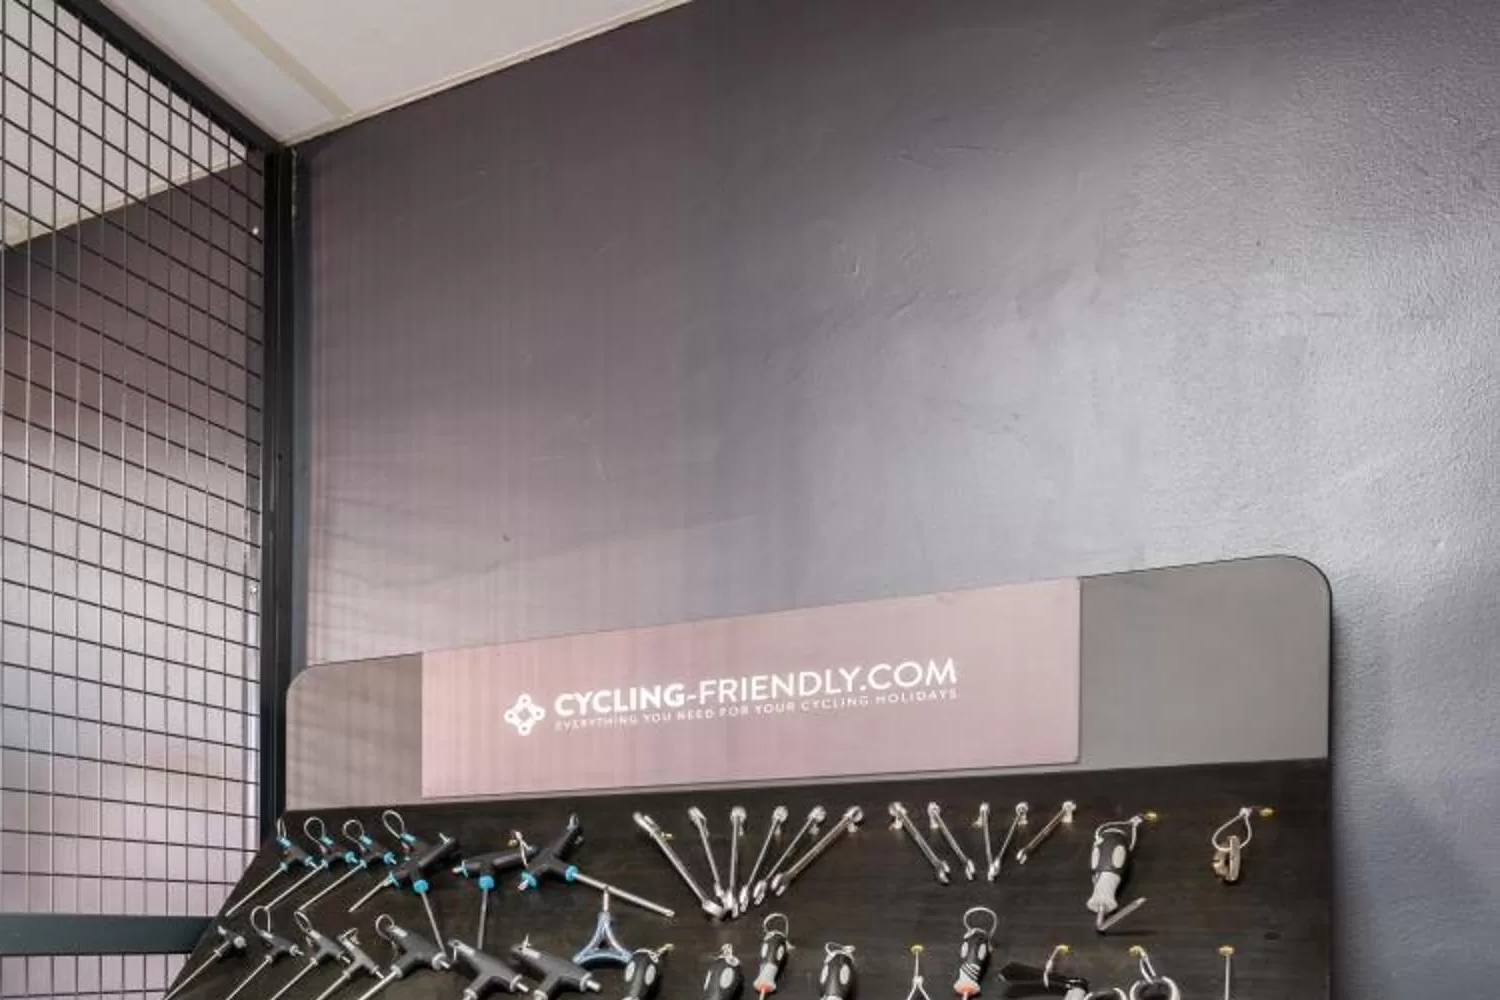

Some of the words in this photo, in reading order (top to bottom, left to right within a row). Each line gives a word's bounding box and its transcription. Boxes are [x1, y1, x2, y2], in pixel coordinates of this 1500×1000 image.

[553, 657, 958, 718] CYCLING-FRIENDLY.COM
[555, 714, 638, 730] EVERYTHING
[643, 711, 671, 724] YOU
[676, 707, 715, 721] NEED
[719, 704, 749, 717] FOR
[755, 701, 796, 716] YOUR
[801, 695, 870, 711] CYCLING
[875, 688, 958, 704] HOLIDAYS
